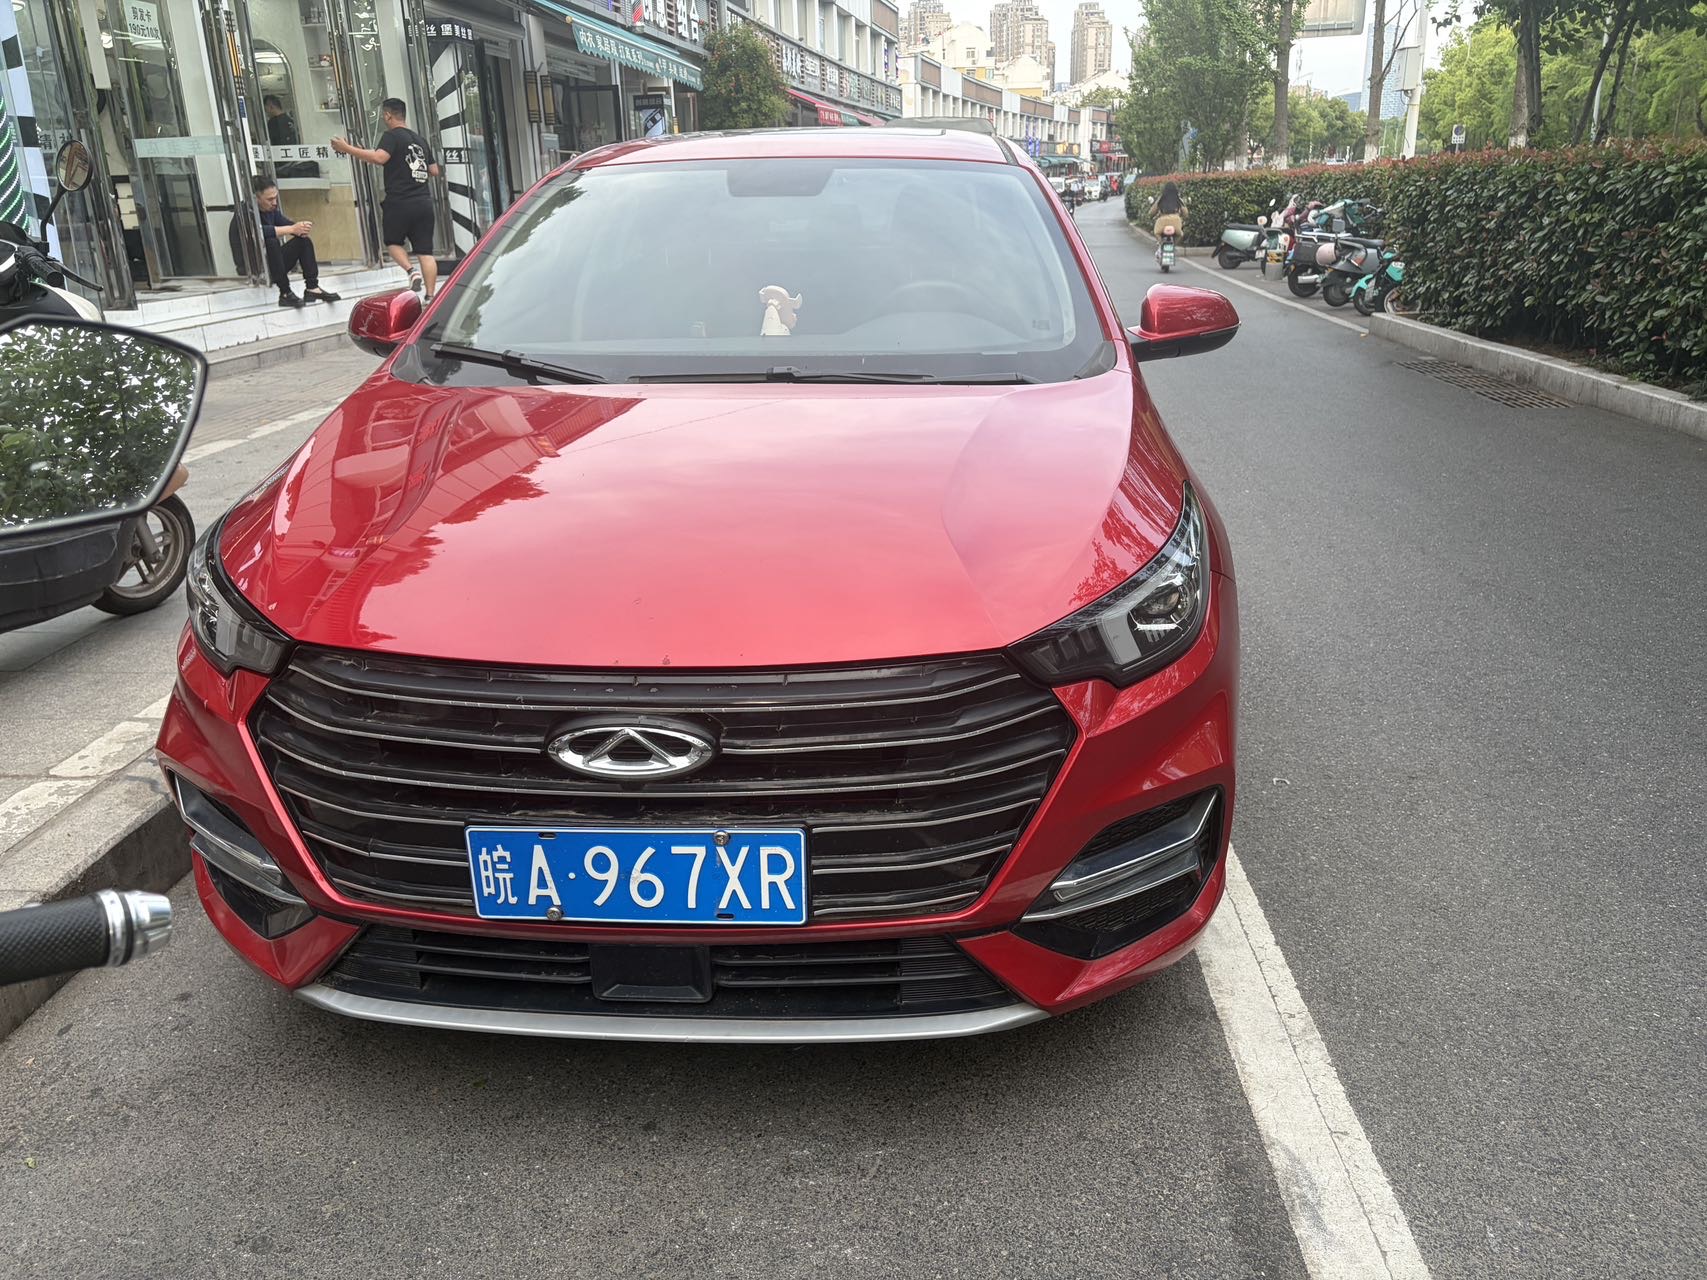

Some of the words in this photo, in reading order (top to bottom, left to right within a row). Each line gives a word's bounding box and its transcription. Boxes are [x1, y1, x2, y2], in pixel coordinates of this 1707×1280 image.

[131, 6, 152, 22] 剪发卡
[129, 23, 161, 39] 190元10次
